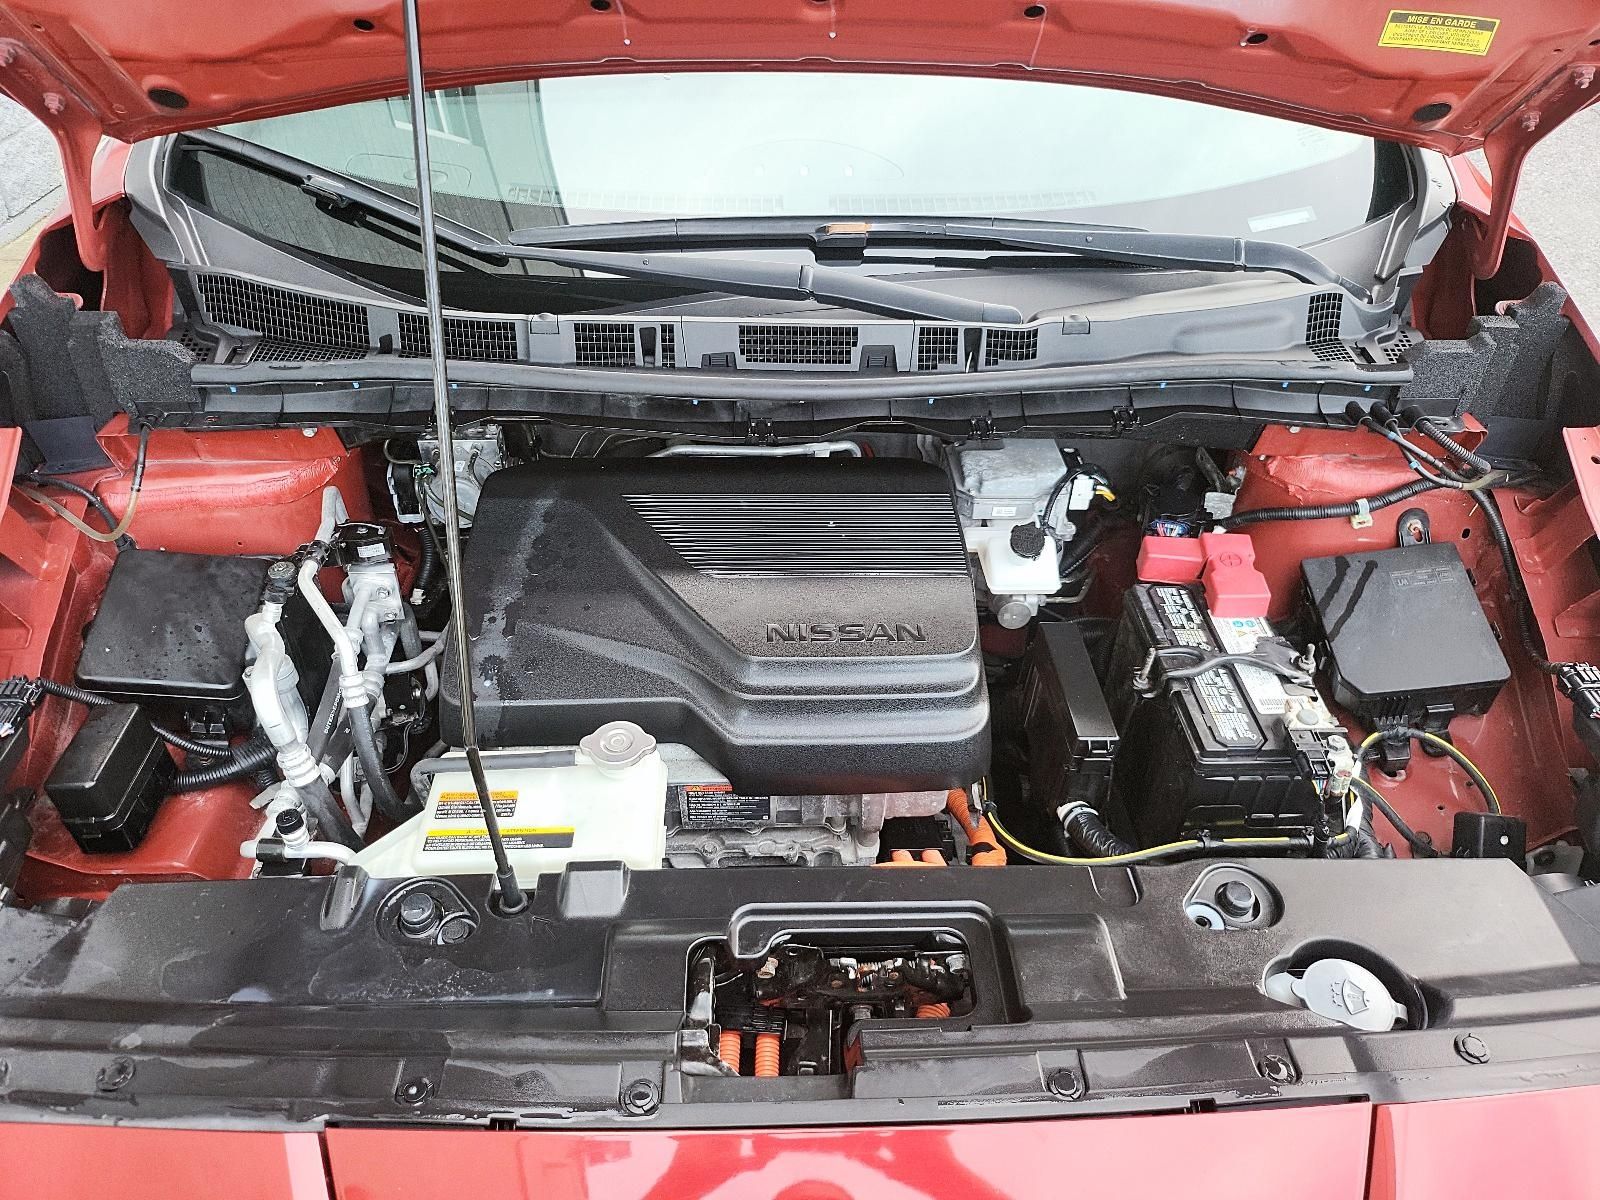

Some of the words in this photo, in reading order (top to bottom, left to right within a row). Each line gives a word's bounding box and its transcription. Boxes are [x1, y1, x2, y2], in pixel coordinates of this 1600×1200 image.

[1407, 15, 1428, 24] MISE
[1430, 17, 1443, 25] EN
[1445, 18, 1477, 28] GARDE
[766, 623, 927, 643] NISSAN
